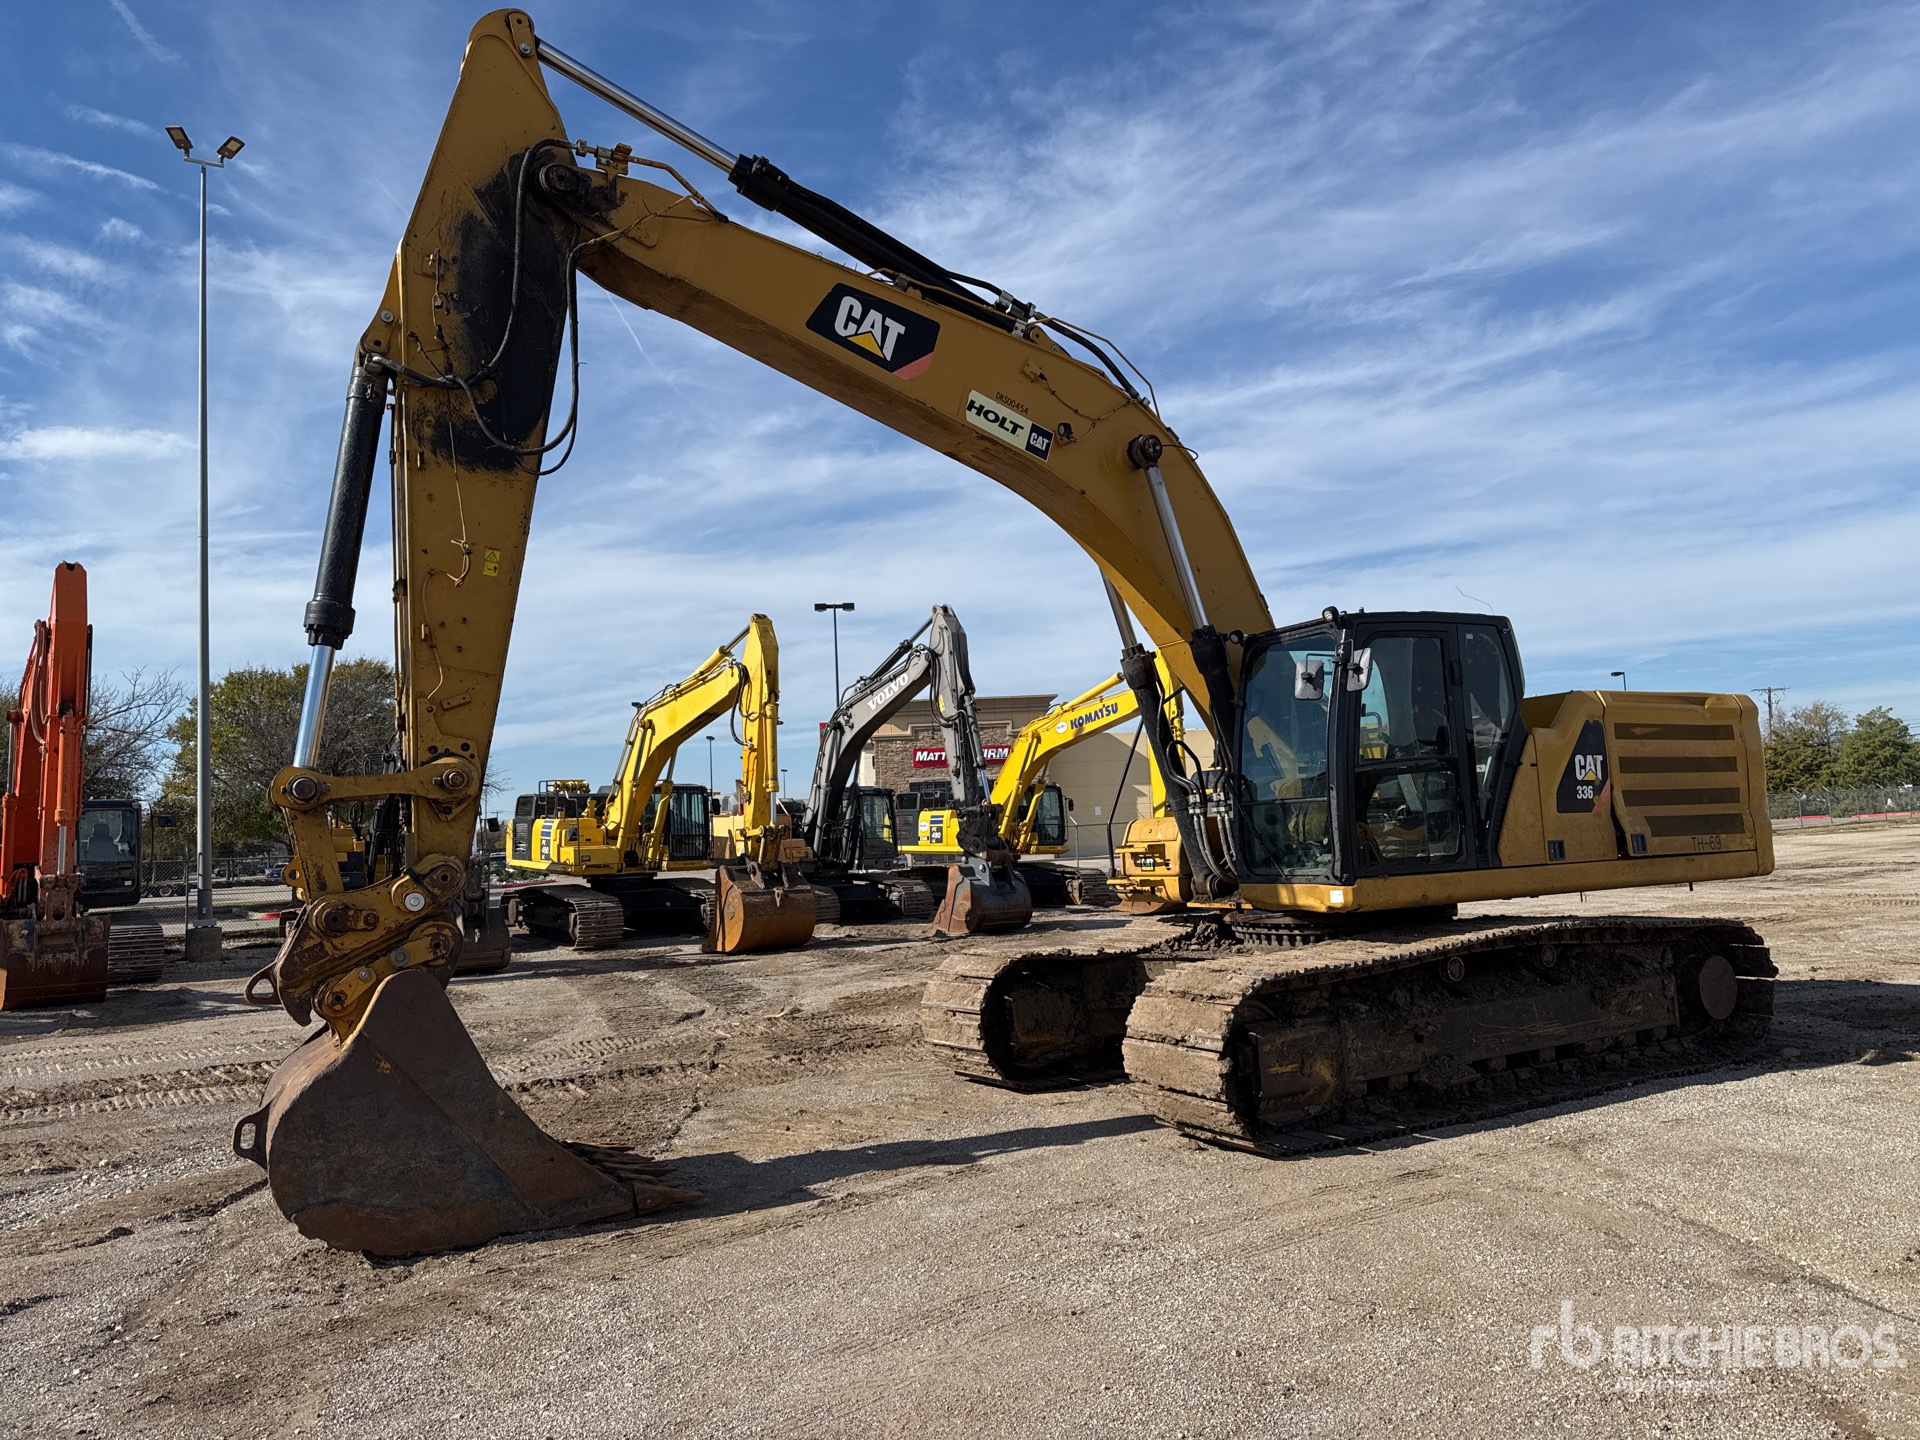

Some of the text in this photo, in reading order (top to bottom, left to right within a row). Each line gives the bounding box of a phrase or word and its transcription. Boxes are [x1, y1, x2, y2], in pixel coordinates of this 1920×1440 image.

[834, 295, 906, 362] CAT
[966, 399, 1049, 451] HOLT CAT
[867, 673, 909, 711] VOLVO
[1070, 702, 1119, 730] KOMATSU
[915, 747, 1009, 762] MATT IRM
[1574, 754, 1603, 781] CAT
[1576, 785, 1594, 800] 336
[1690, 835, 1722, 851] TH-69
